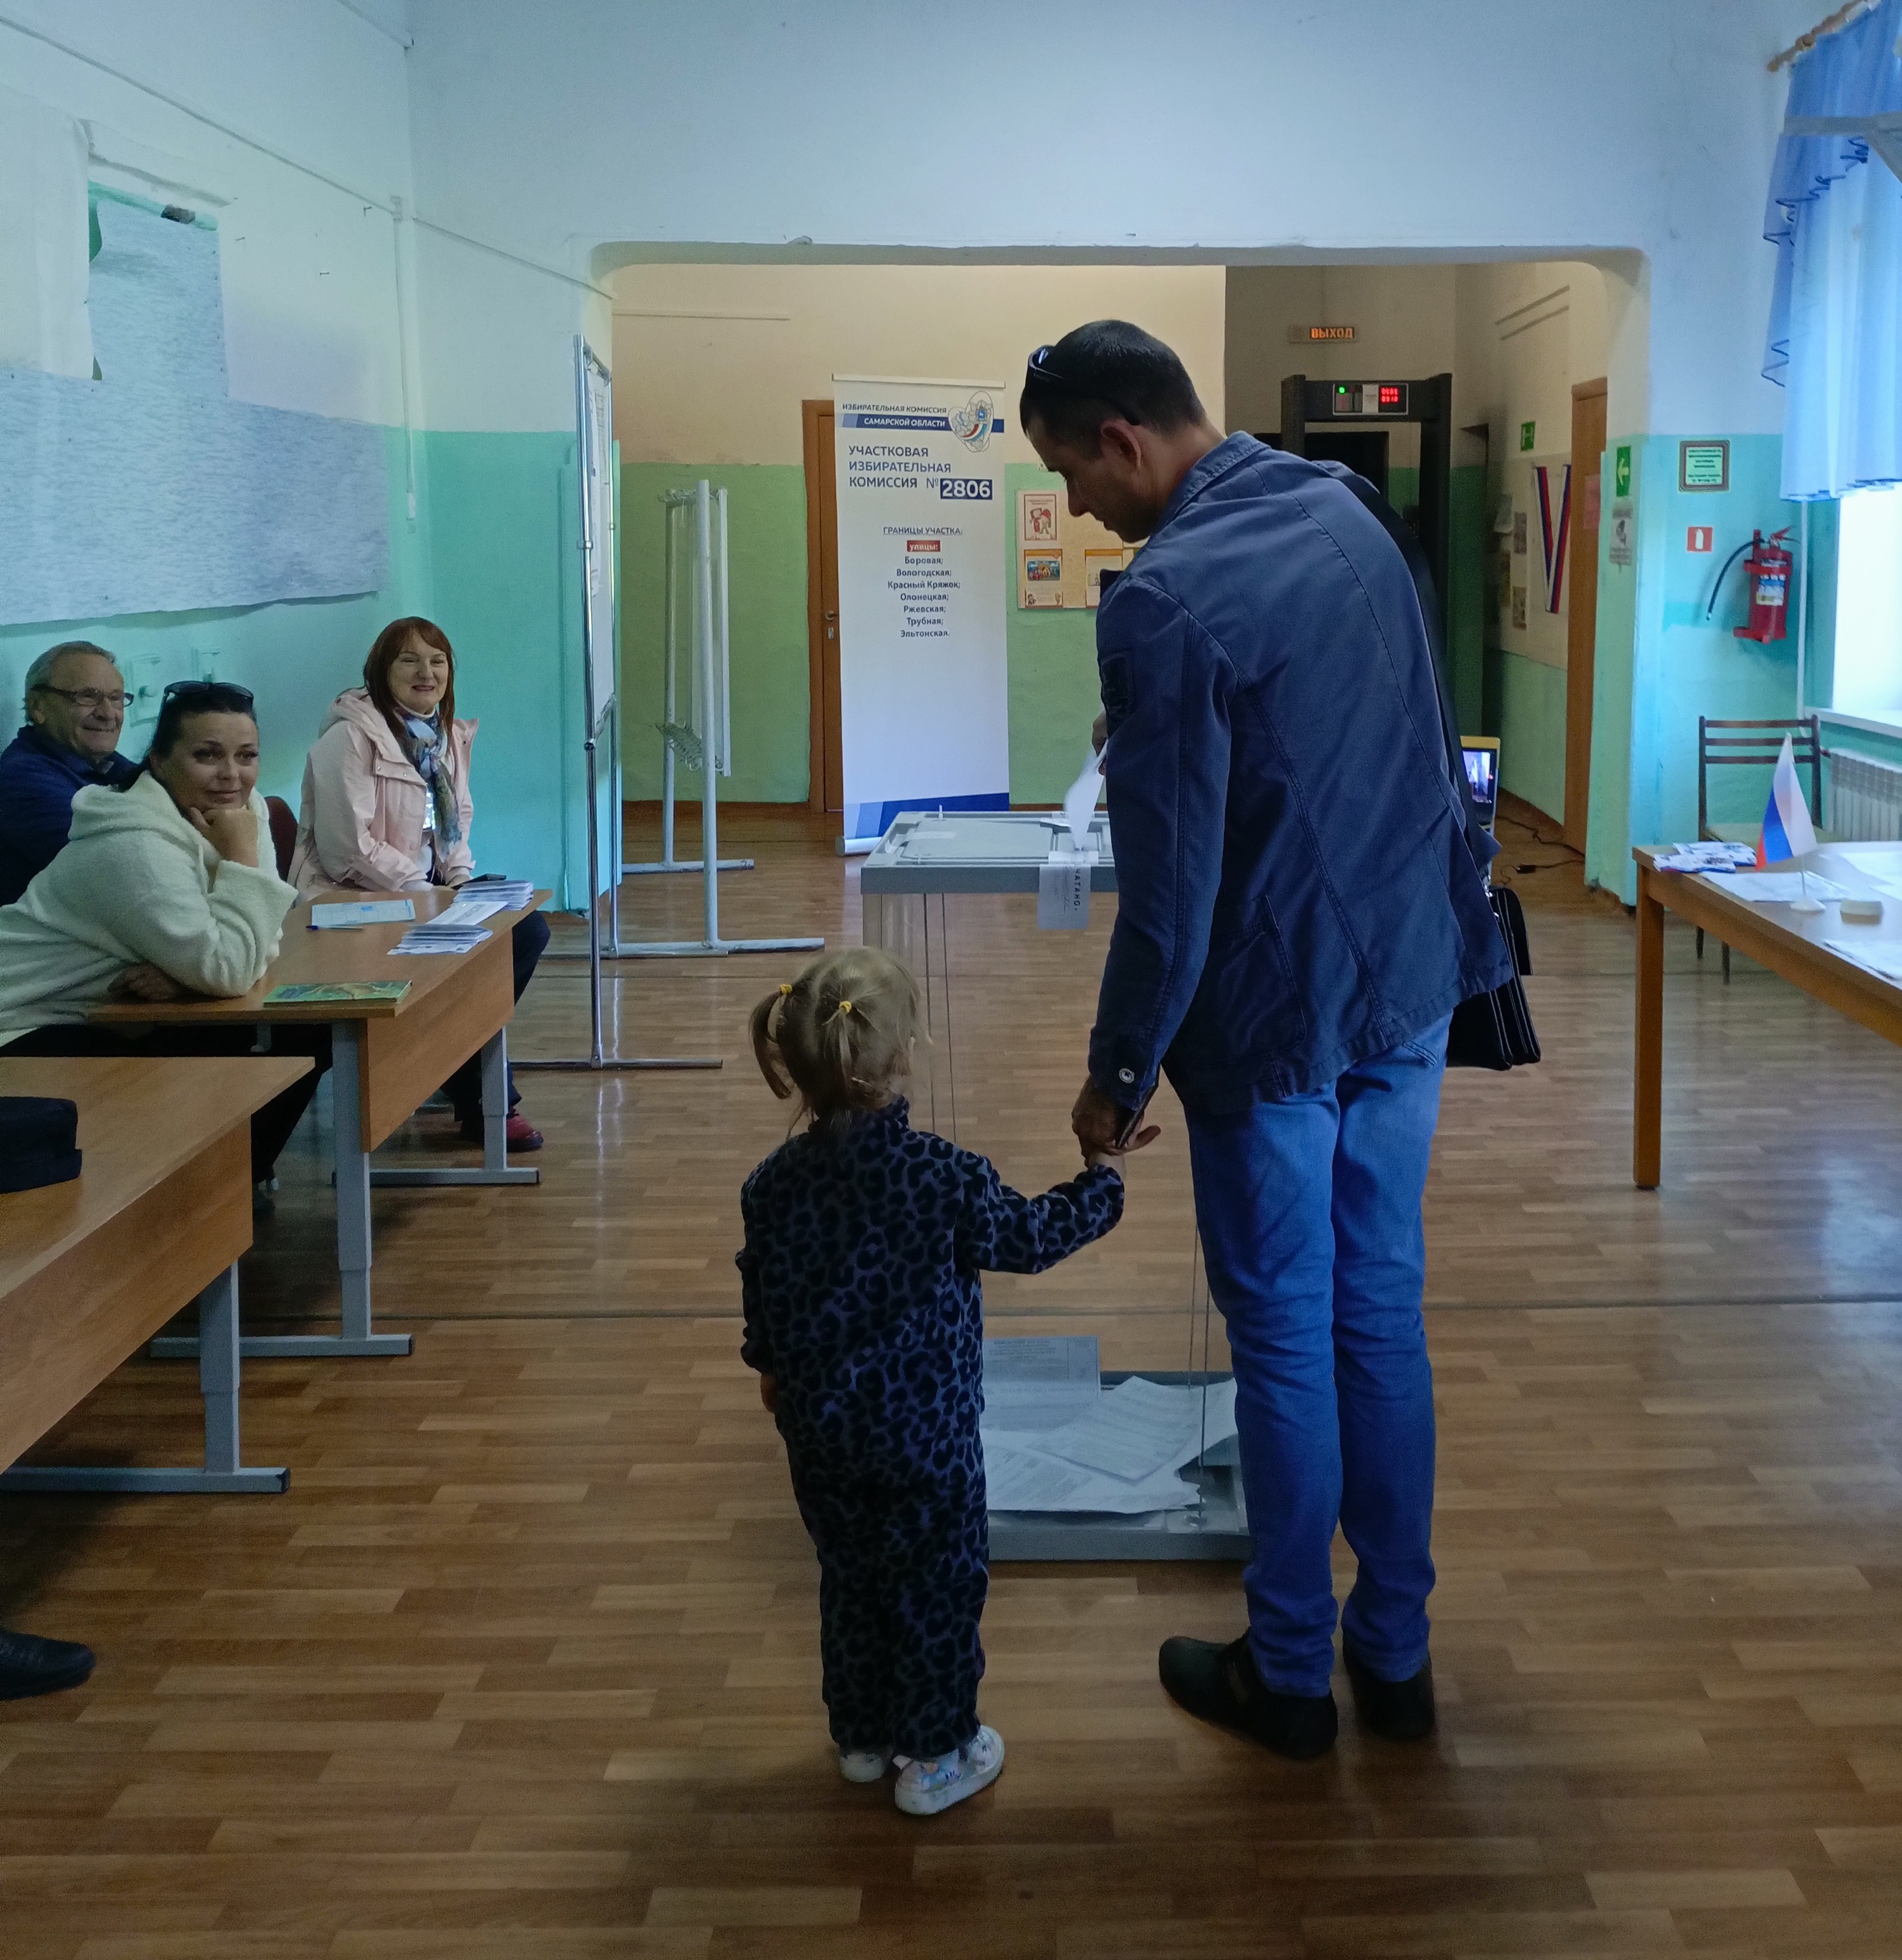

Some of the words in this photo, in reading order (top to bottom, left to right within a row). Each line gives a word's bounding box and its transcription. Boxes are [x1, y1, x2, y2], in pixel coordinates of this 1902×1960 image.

[1311, 327, 1353, 339] ВЫХОД
[842, 403, 905, 412] ИЗБИРАТЕЛЬНАЯ
[864, 417, 910, 426] САМАРСКОЙ
[911, 419, 945, 427] ОБЛАСТИ
[849, 446, 929, 457] УЧАСТКОВАЯ
[849, 461, 951, 473] ИЗБИРАТЕЛЬНАЯ
[849, 477, 917, 488] КОМИССИЯ
[942, 480, 991, 498] 2806
[883, 527, 923, 536] ГРАНИЦЫ
[926, 527, 962, 535] УЧАСТКА:
[909, 543, 938, 552] улицы:
[905, 556, 943, 566] Боровая;
[896, 568, 952, 578] Вологодская;
[887, 581, 925, 590] Красный
[927, 581, 961, 590] Кряжок;
[900, 593, 949, 602] Олонецкая;
[903, 605, 946, 614] Ржевская;
[907, 617, 943, 627] Трубная;
